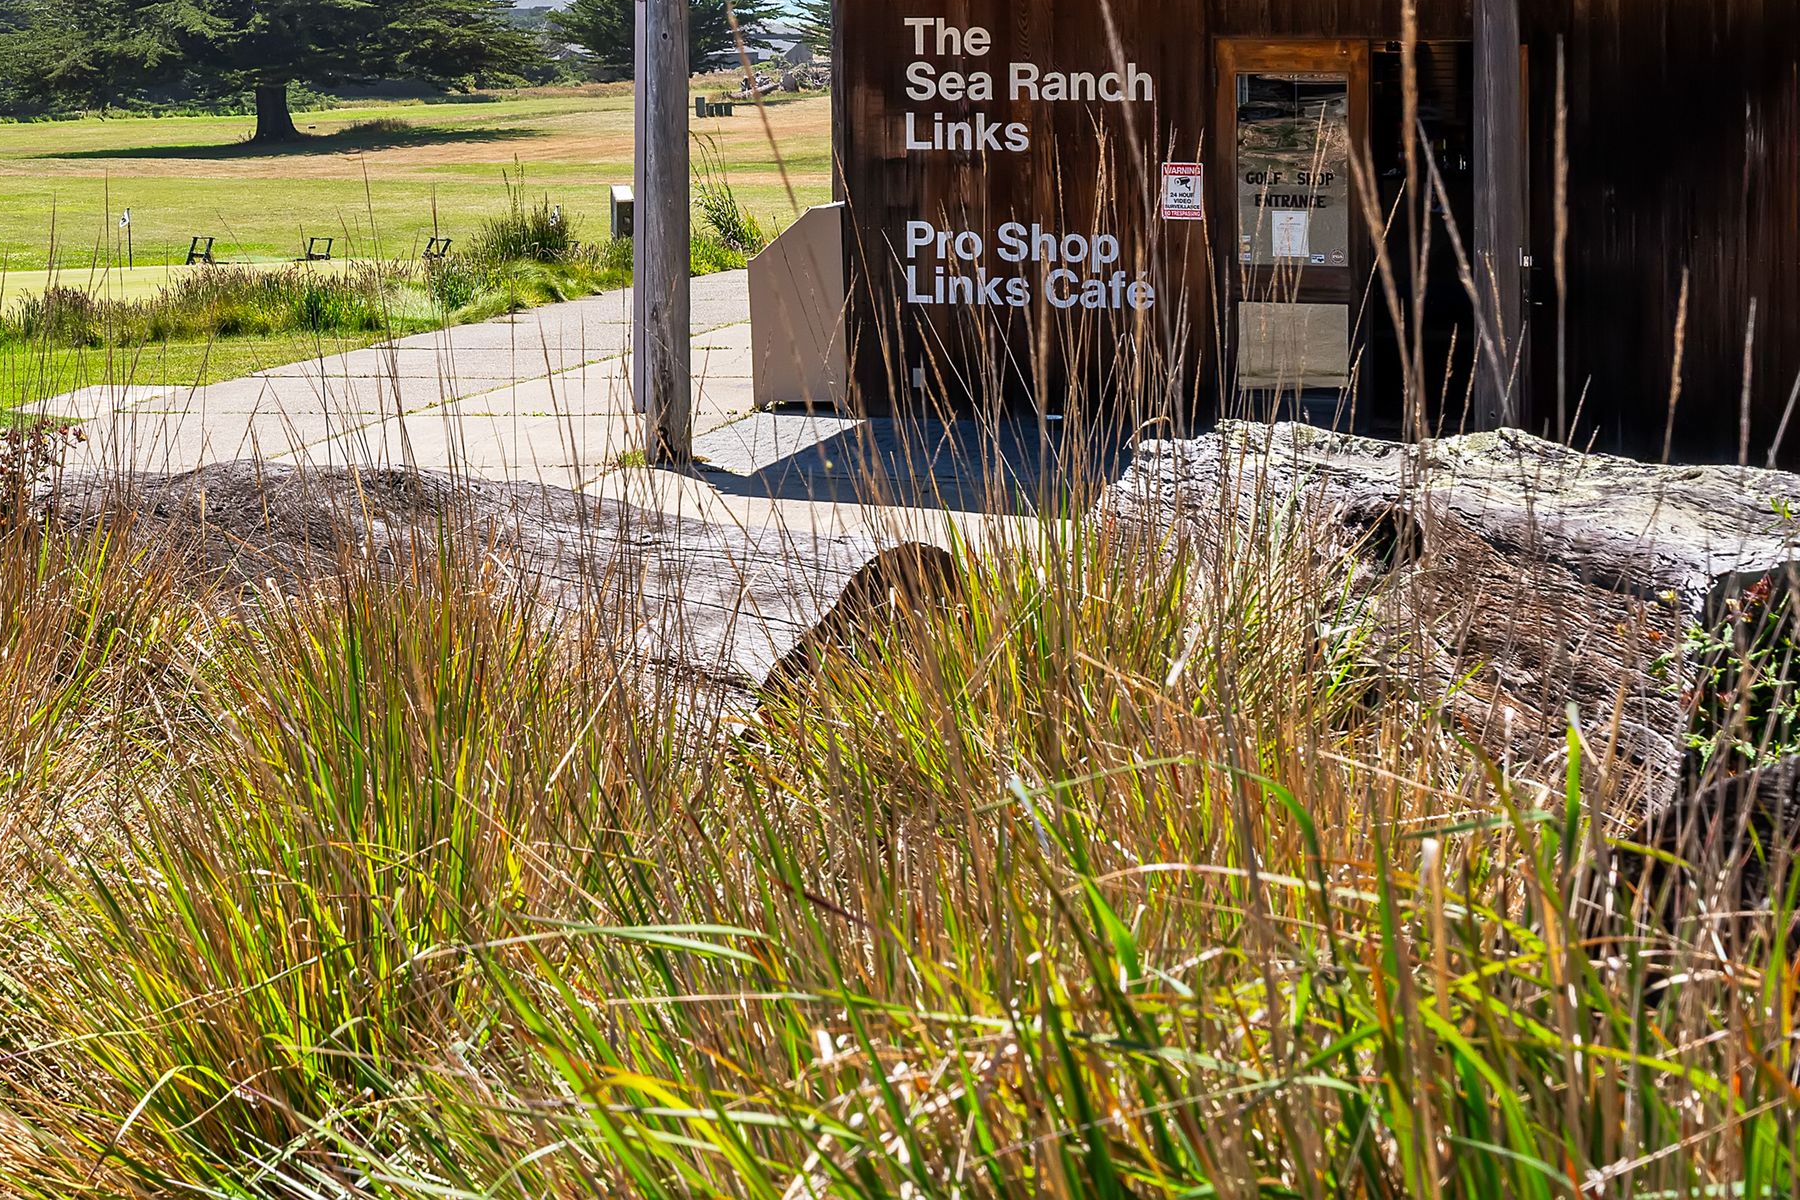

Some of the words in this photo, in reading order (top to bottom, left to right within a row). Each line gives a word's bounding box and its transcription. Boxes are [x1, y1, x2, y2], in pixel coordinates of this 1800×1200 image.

[904, 17, 991, 56] The
[905, 61, 993, 101] Sea
[1009, 63, 1153, 101] Ranch
[905, 112, 1030, 151] Links
[1164, 166, 1201, 175] WARNING
[1245, 172, 1283, 185] GOLF
[1297, 172, 1334, 186] SHOP
[1254, 194, 1327, 208] ENTRANCE
[906, 220, 983, 260] Pro
[997, 221, 1119, 273] Shop
[907, 265, 1030, 306] Links
[1046, 268, 1155, 310] Café
